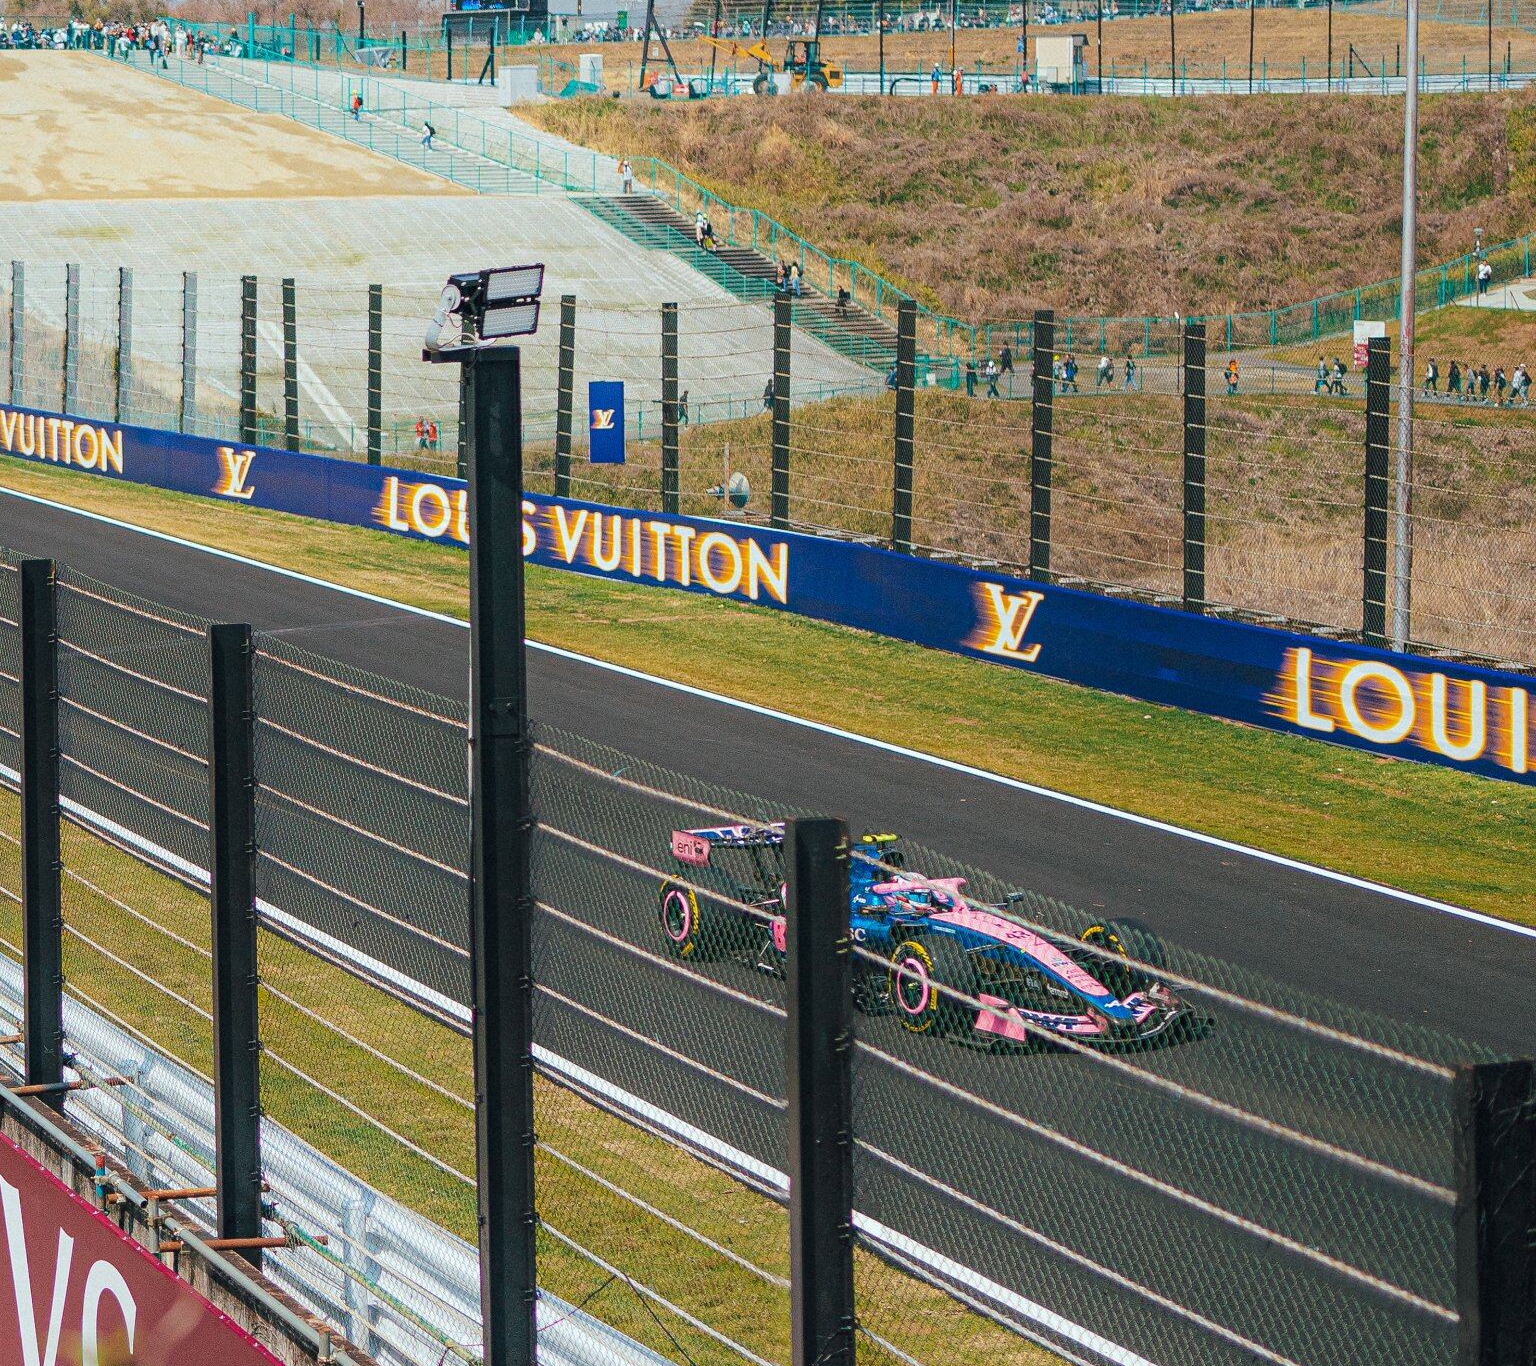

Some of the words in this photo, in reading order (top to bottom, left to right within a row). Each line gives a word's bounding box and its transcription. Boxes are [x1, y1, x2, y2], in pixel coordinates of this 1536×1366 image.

[388, 476, 537, 557] LOS
[554, 506, 789, 605] VUITTON
[1294, 647, 1536, 774] LOUI
[677, 841, 693, 854] eni
